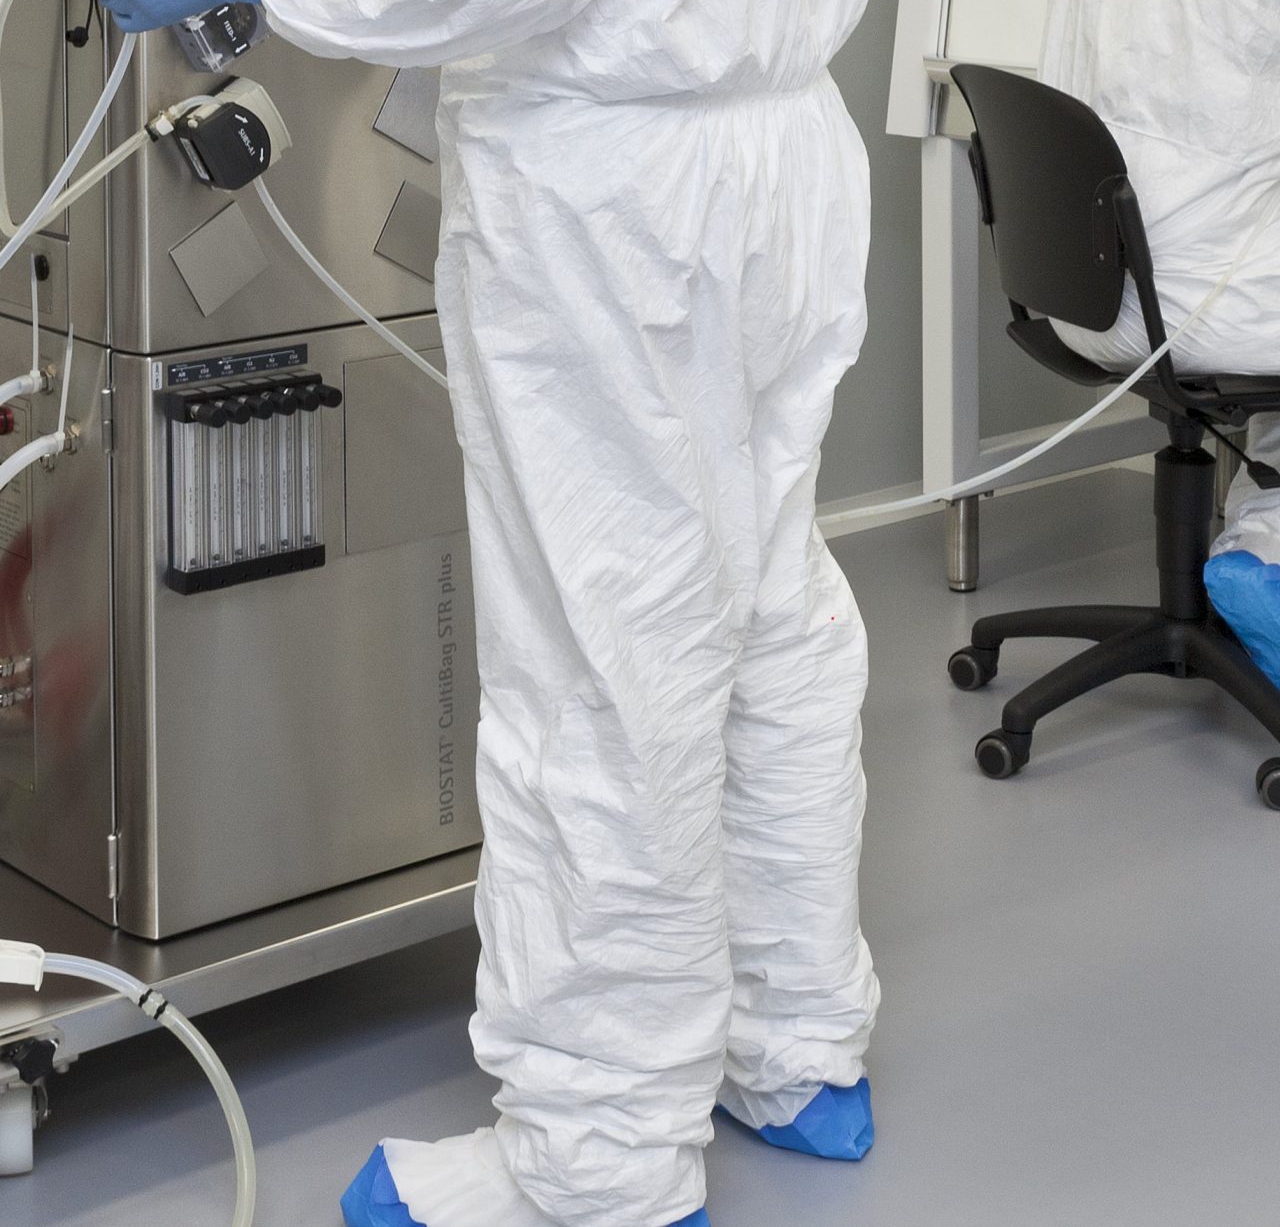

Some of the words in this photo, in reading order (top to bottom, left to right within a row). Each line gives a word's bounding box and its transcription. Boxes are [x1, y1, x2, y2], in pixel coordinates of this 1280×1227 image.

[223, 20, 237, 42] FEED-1
[438, 553, 456, 595] plus
[438, 600, 453, 639] STR
[438, 642, 457, 730] CultiBag
[439, 742, 454, 826] BIOSTAT
